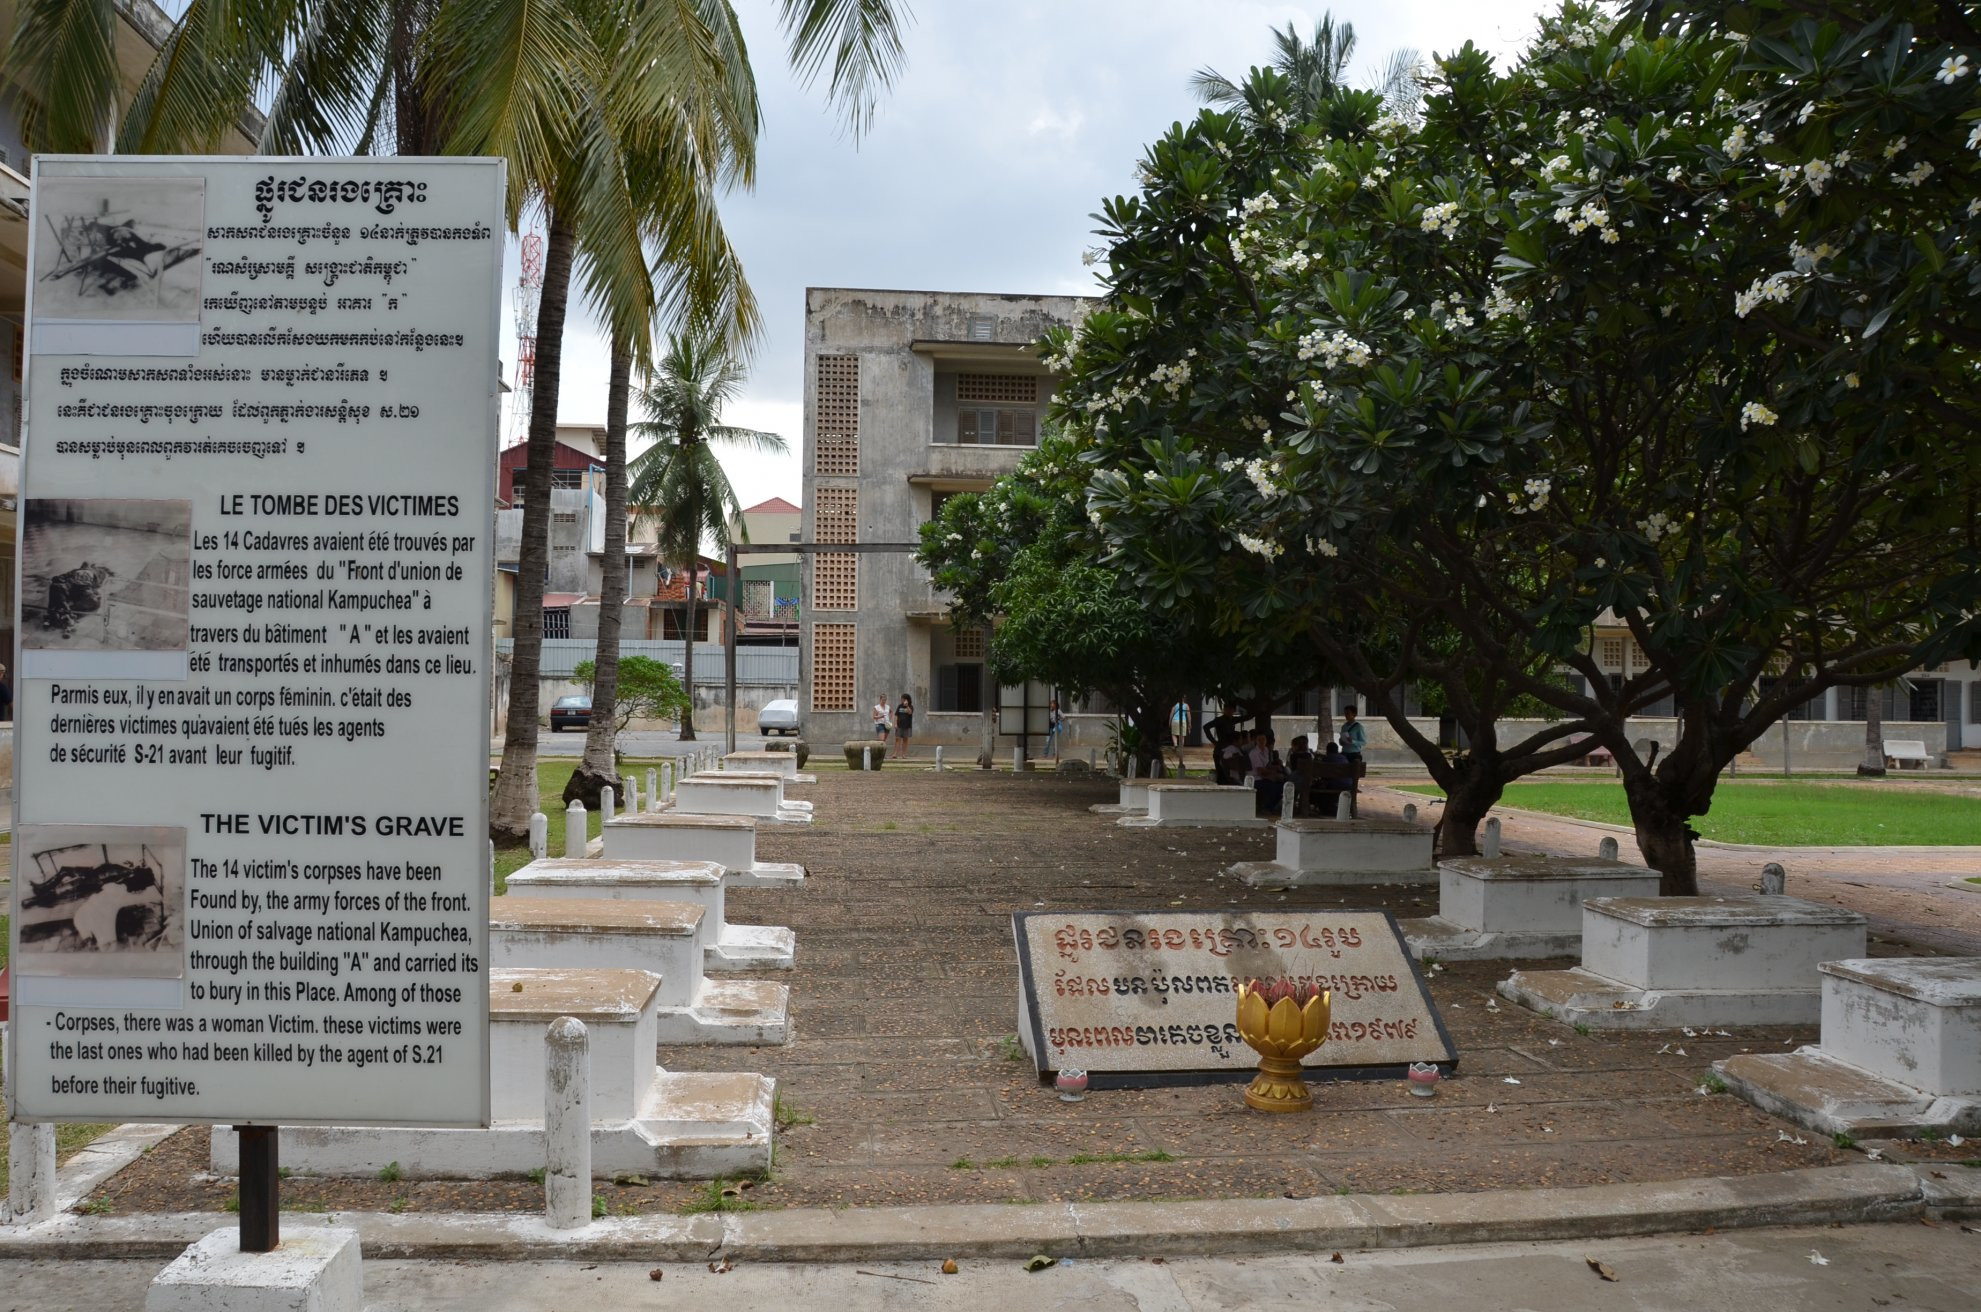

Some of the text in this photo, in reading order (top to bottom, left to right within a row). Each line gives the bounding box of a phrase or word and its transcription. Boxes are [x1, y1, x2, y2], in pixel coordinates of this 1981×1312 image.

[221, 495, 459, 516] LE TOMBE DES VICTIMES
[194, 530, 475, 556] Les 14 Cadavres avaient été trouvés par
[193, 560, 462, 581] les force armées du "Front d'union de
[192, 589, 431, 613] sauvetage national Kampuchea" à
[190, 624, 238, 643] travers
[243, 624, 260, 643] du
[265, 623, 327, 644] bâtiment
[375, 625, 389, 644] et
[393, 624, 413, 644] les
[418, 625, 469, 645] avaient
[189, 651, 476, 677] été transportés et inhumés dans ce lieu.
[51, 684, 99, 704] Parmis
[103, 689, 131, 708] eux,
[215, 691, 231, 705] un
[236, 691, 275, 711] corps
[279, 686, 335, 706] féminin.
[340, 687, 382, 707] c'était
[386, 688, 411, 707] des
[51, 713, 115, 734] dernières
[120, 714, 177, 735] victimes
[253, 715, 274, 736] été
[279, 716, 308, 736] tués
[314, 716, 333, 736] les
[338, 718, 385, 742] agents
[50, 743, 294, 770] de sécurité S-21 avant leur fugitif.
[200, 814, 464, 836] THE VICTIM'S GRAVE
[191, 858, 441, 885] The 14 victim's corpses have been
[191, 889, 470, 915] Found by, the army forces of the front.
[191, 920, 471, 947] Union of salvage national Kampuchea,
[190, 950, 480, 976] through the building "A" and carried its
[190, 980, 461, 1007] to bury in this Place. Among of those
[55, 1012, 119, 1035] Corpses,
[124, 1013, 161, 1031] there
[165, 1018, 194, 1032] was
[199, 1018, 207, 1032] a
[211, 1018, 264, 1032] woman
[268, 1014, 318, 1033] Victim.
[323, 1015, 363, 1034] these
[368, 1016, 421, 1035] victims
[426, 1021, 461, 1035] were
[50, 1041, 442, 1068] the last ones who had been killed by the agent of S.21
[52, 1075, 199, 1100] before their fugitive.
